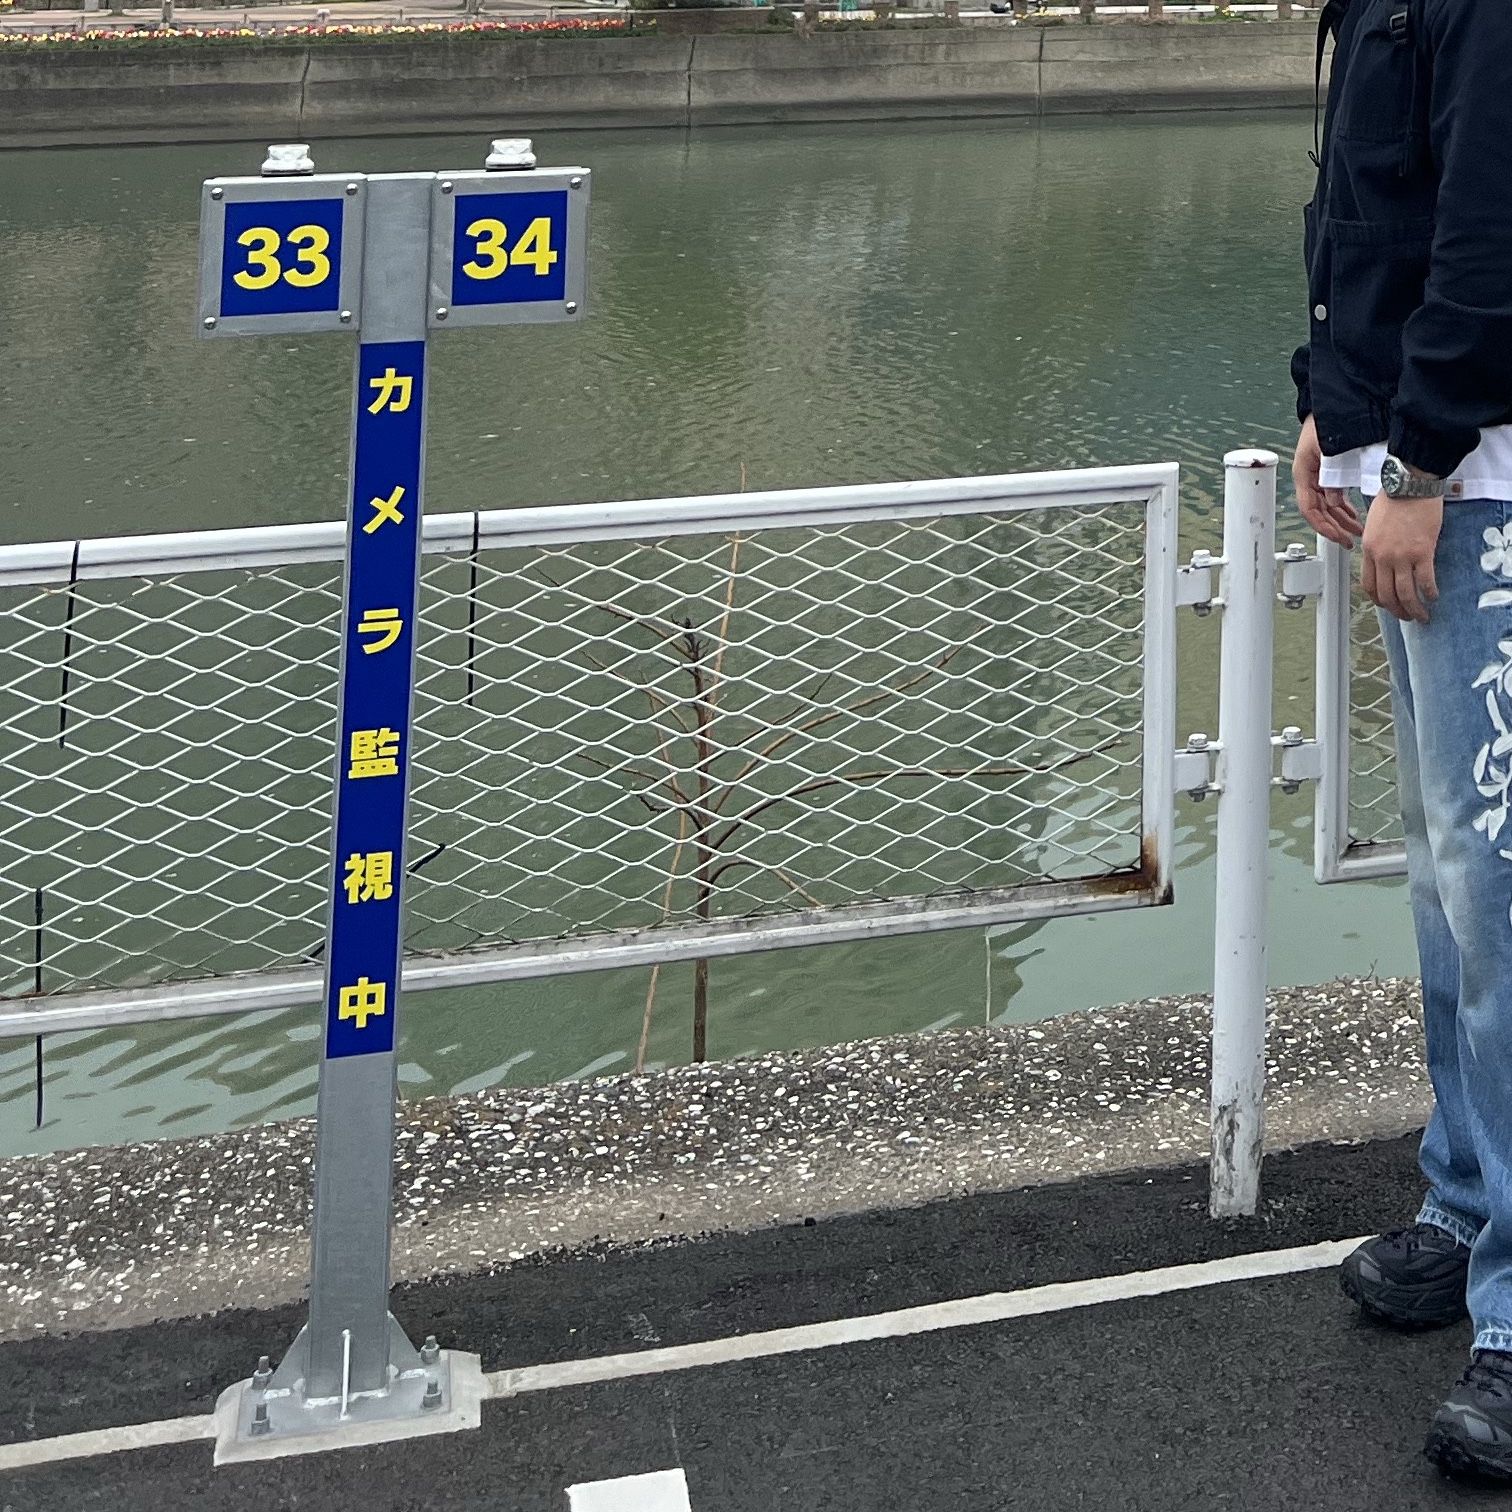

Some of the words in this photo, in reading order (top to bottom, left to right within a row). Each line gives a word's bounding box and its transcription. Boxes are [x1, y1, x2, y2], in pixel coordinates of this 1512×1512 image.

[233, 225, 331, 290] 33
[462, 217, 558, 280] 34
[338, 367, 413, 1029] カメラ監視中
